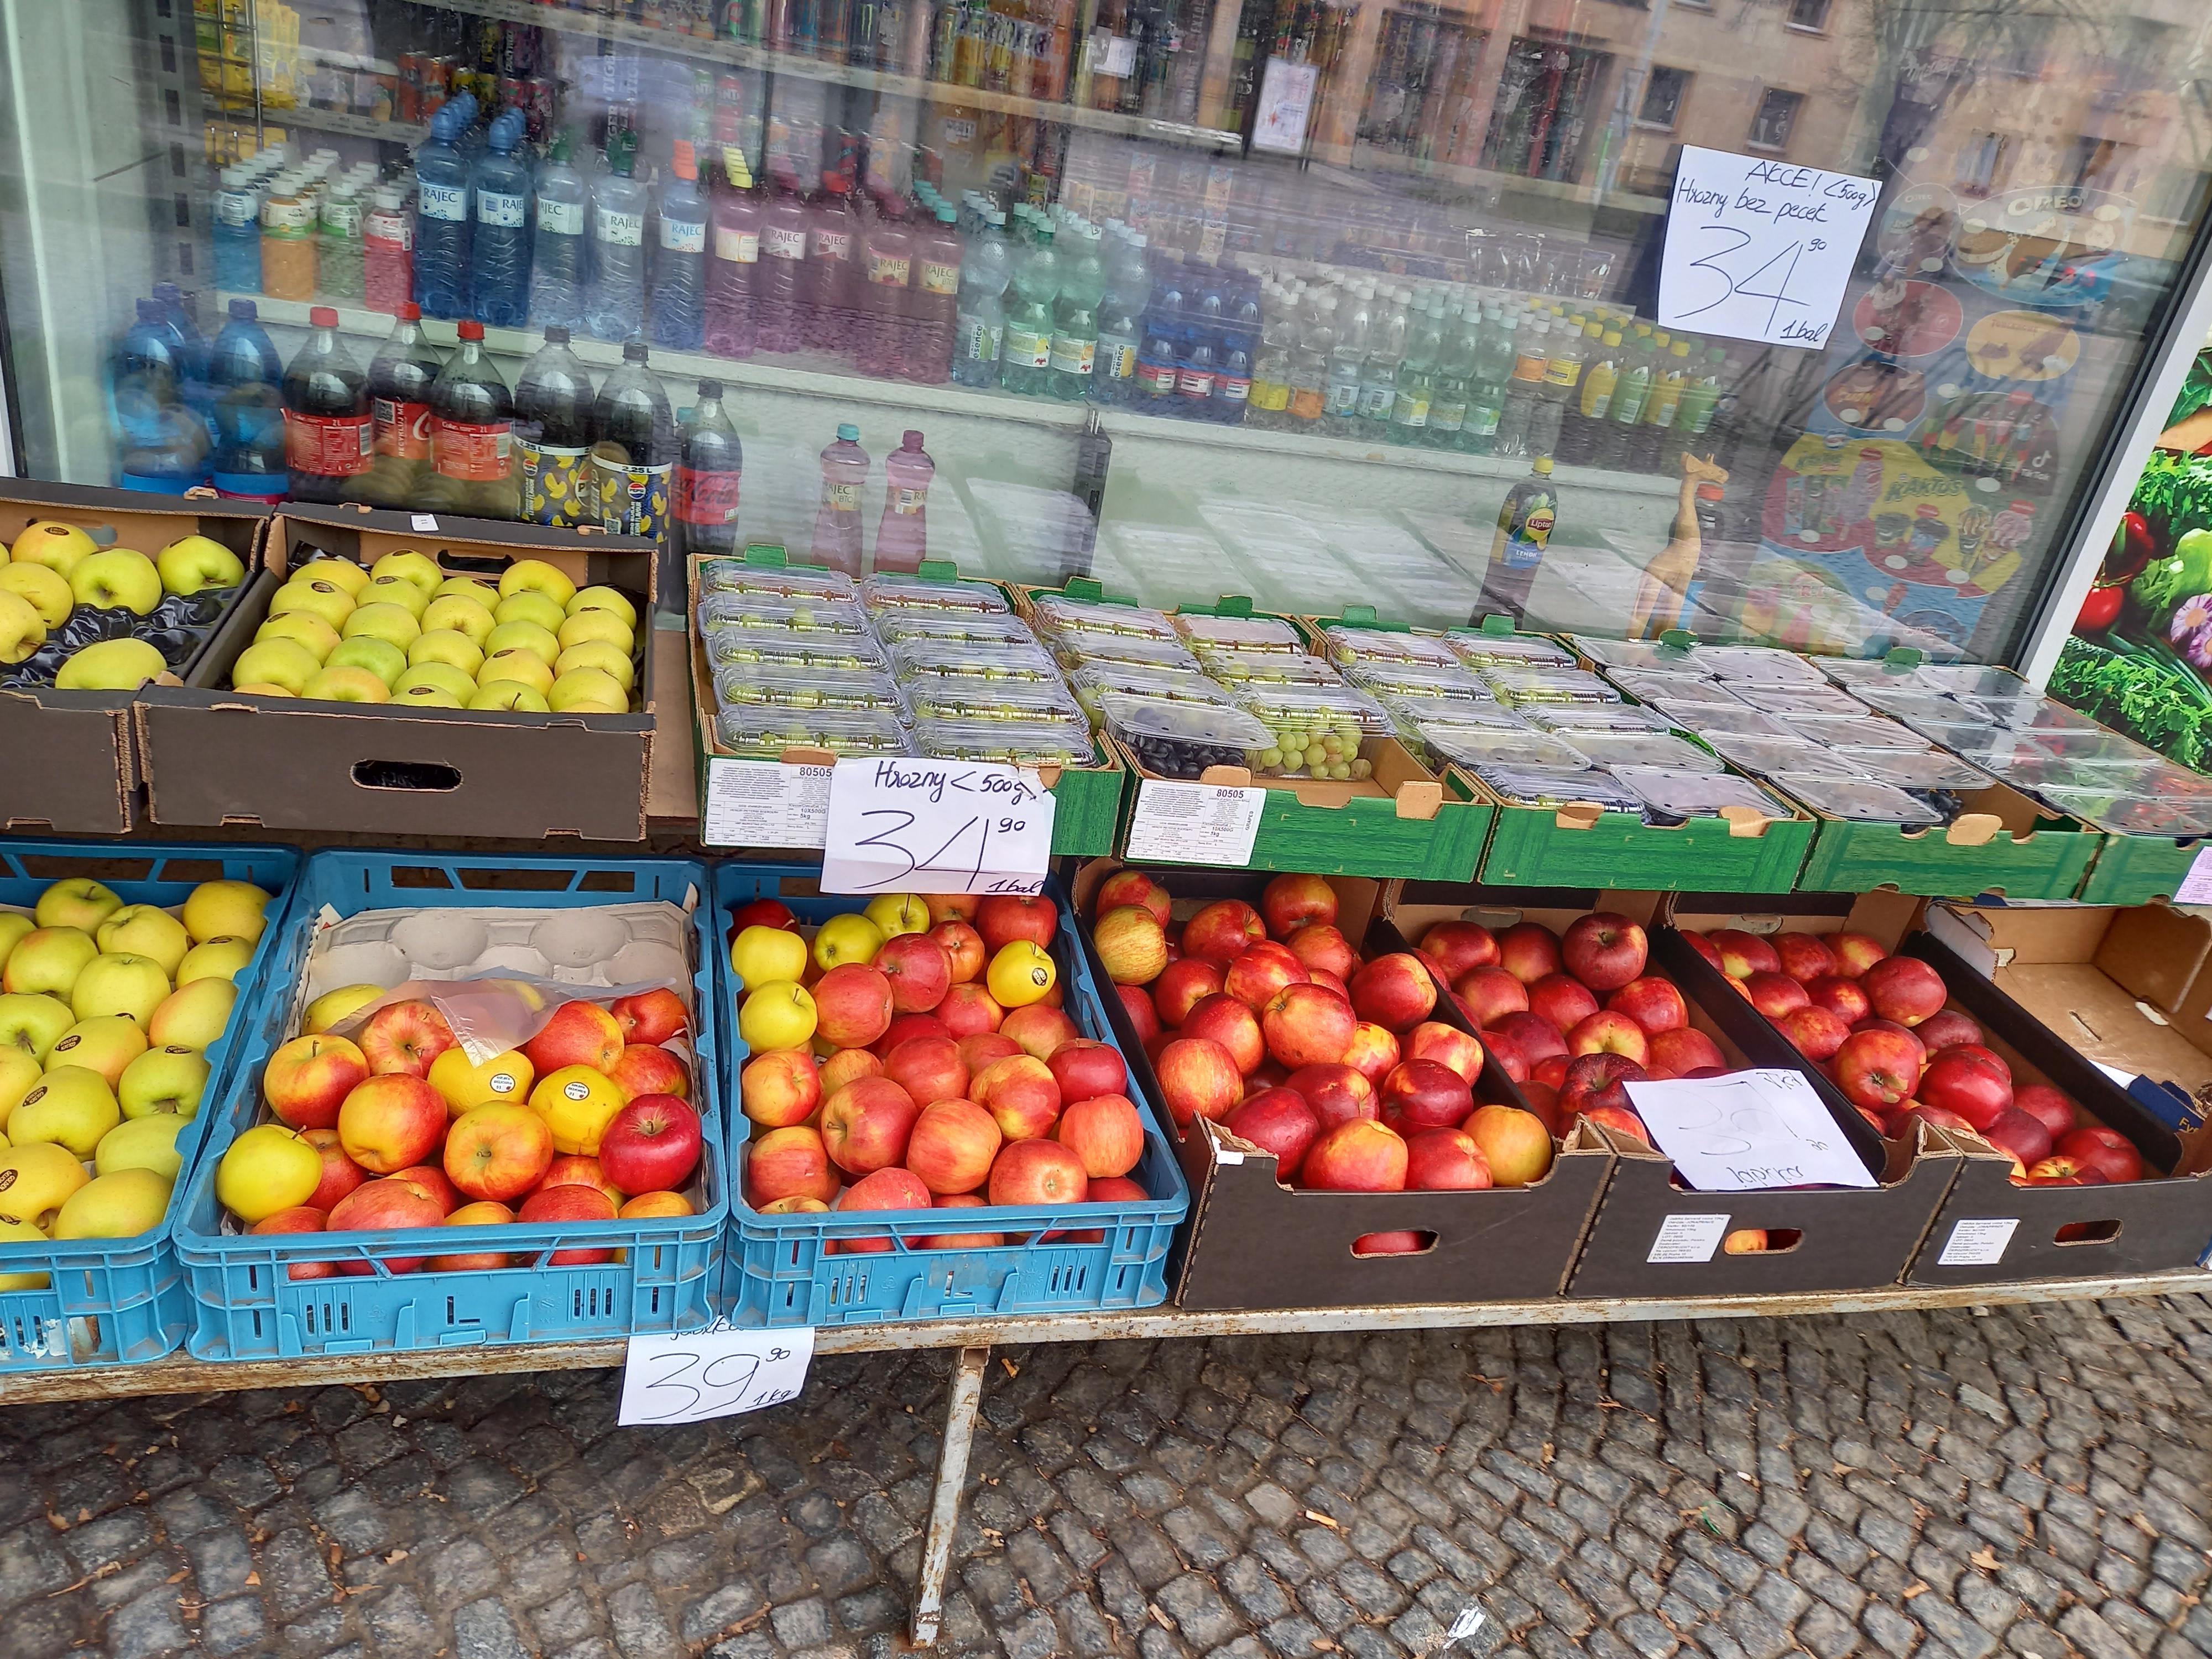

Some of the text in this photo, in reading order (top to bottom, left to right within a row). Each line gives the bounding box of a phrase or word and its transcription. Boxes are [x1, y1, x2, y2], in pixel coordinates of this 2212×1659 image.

[1745, 161, 1823, 197] AKCE!
[424, 187, 458, 203] RAJEC
[1734, 187, 1772, 213] bez
[502, 199, 523, 211] RAJE
[540, 201, 564, 215] AJEC
[2007, 195, 2083, 216] OREO
[611, 216, 640, 229] RAJEC
[672, 223, 701, 237] RAJEC
[771, 229, 800, 243] RAJEC
[818, 233, 846, 246] RAJEC
[880, 259, 907, 271] RAJEC
[925, 265, 954, 278] RAJEC
[1673, 226, 1827, 337] 34 90
[973, 325, 983, 359] esence
[1114, 345, 1125, 377] esence
[1516, 550, 1537, 558] LEMON
[800, 767, 832, 776] 80505
[874, 760, 947, 803] Hrozny
[1216, 789, 1244, 799] 80505
[852, 810, 1025, 893] 34 90
[640, 1348, 791, 1420] 39 90
